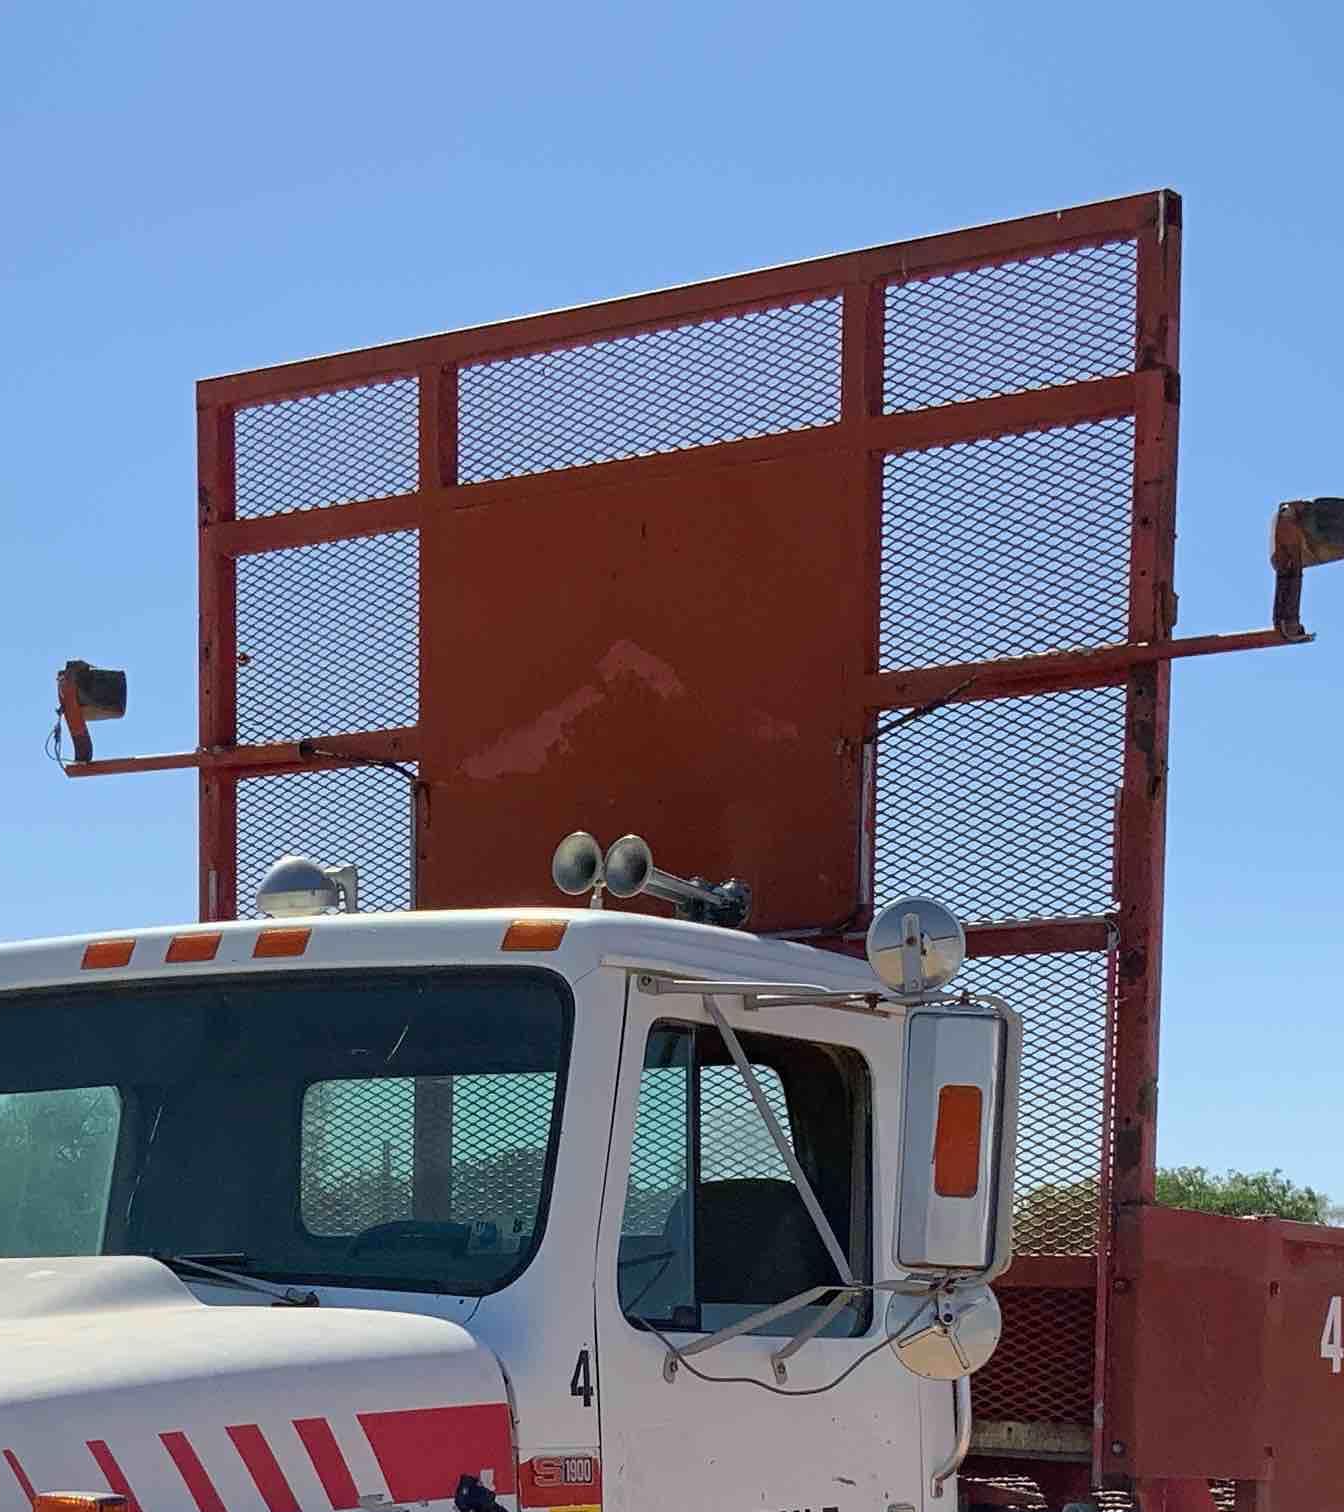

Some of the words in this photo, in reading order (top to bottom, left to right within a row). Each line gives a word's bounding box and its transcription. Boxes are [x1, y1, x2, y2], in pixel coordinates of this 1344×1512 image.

[1320, 1295, 1344, 1373] 4
[570, 1349, 594, 1407] 4
[564, 1458, 591, 1483] 1900
